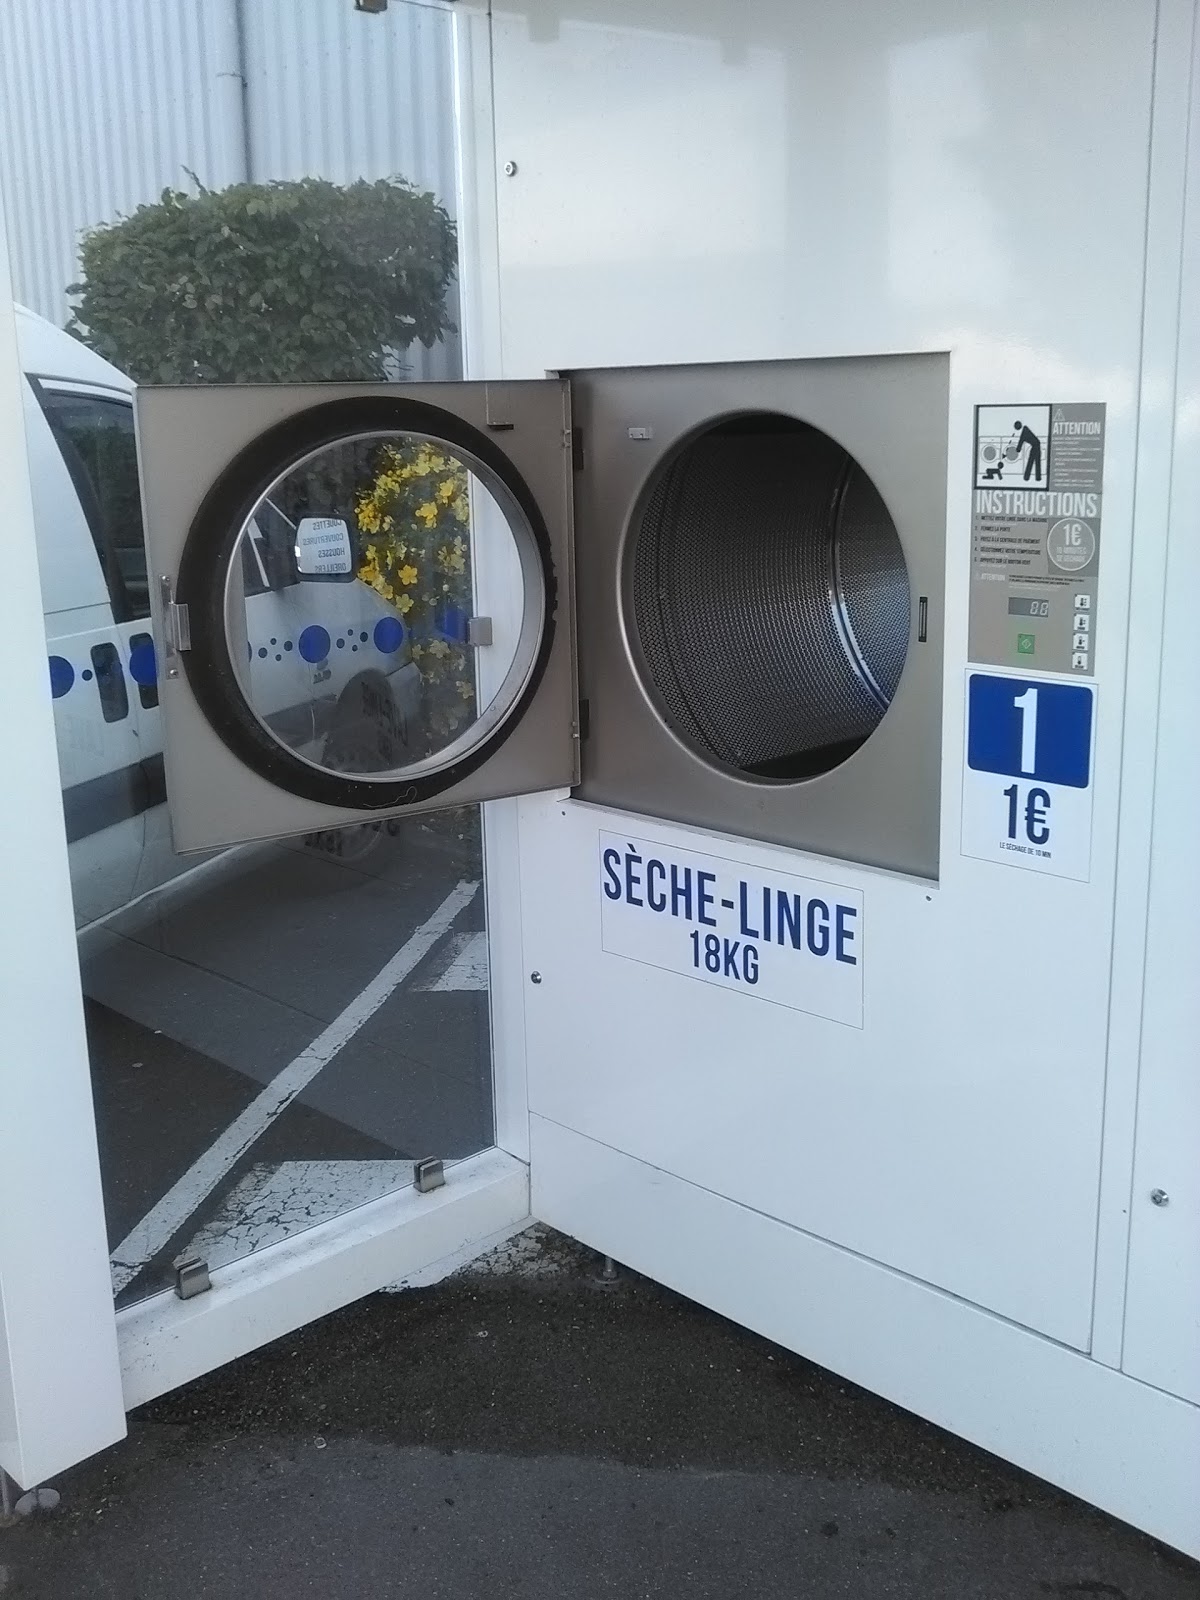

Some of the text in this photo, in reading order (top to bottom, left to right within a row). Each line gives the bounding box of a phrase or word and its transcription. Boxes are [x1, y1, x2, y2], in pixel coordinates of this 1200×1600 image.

[1052, 421, 1101, 435] ATTENTION
[975, 490, 1098, 518] INSTRUCTIONS
[1063, 523, 1082, 546] 1€
[1014, 687, 1038, 774] 1
[1003, 784, 1051, 845] 1€
[603, 842, 857, 966] SÈCHE-LINGE
[689, 929, 760, 985] 18KG
